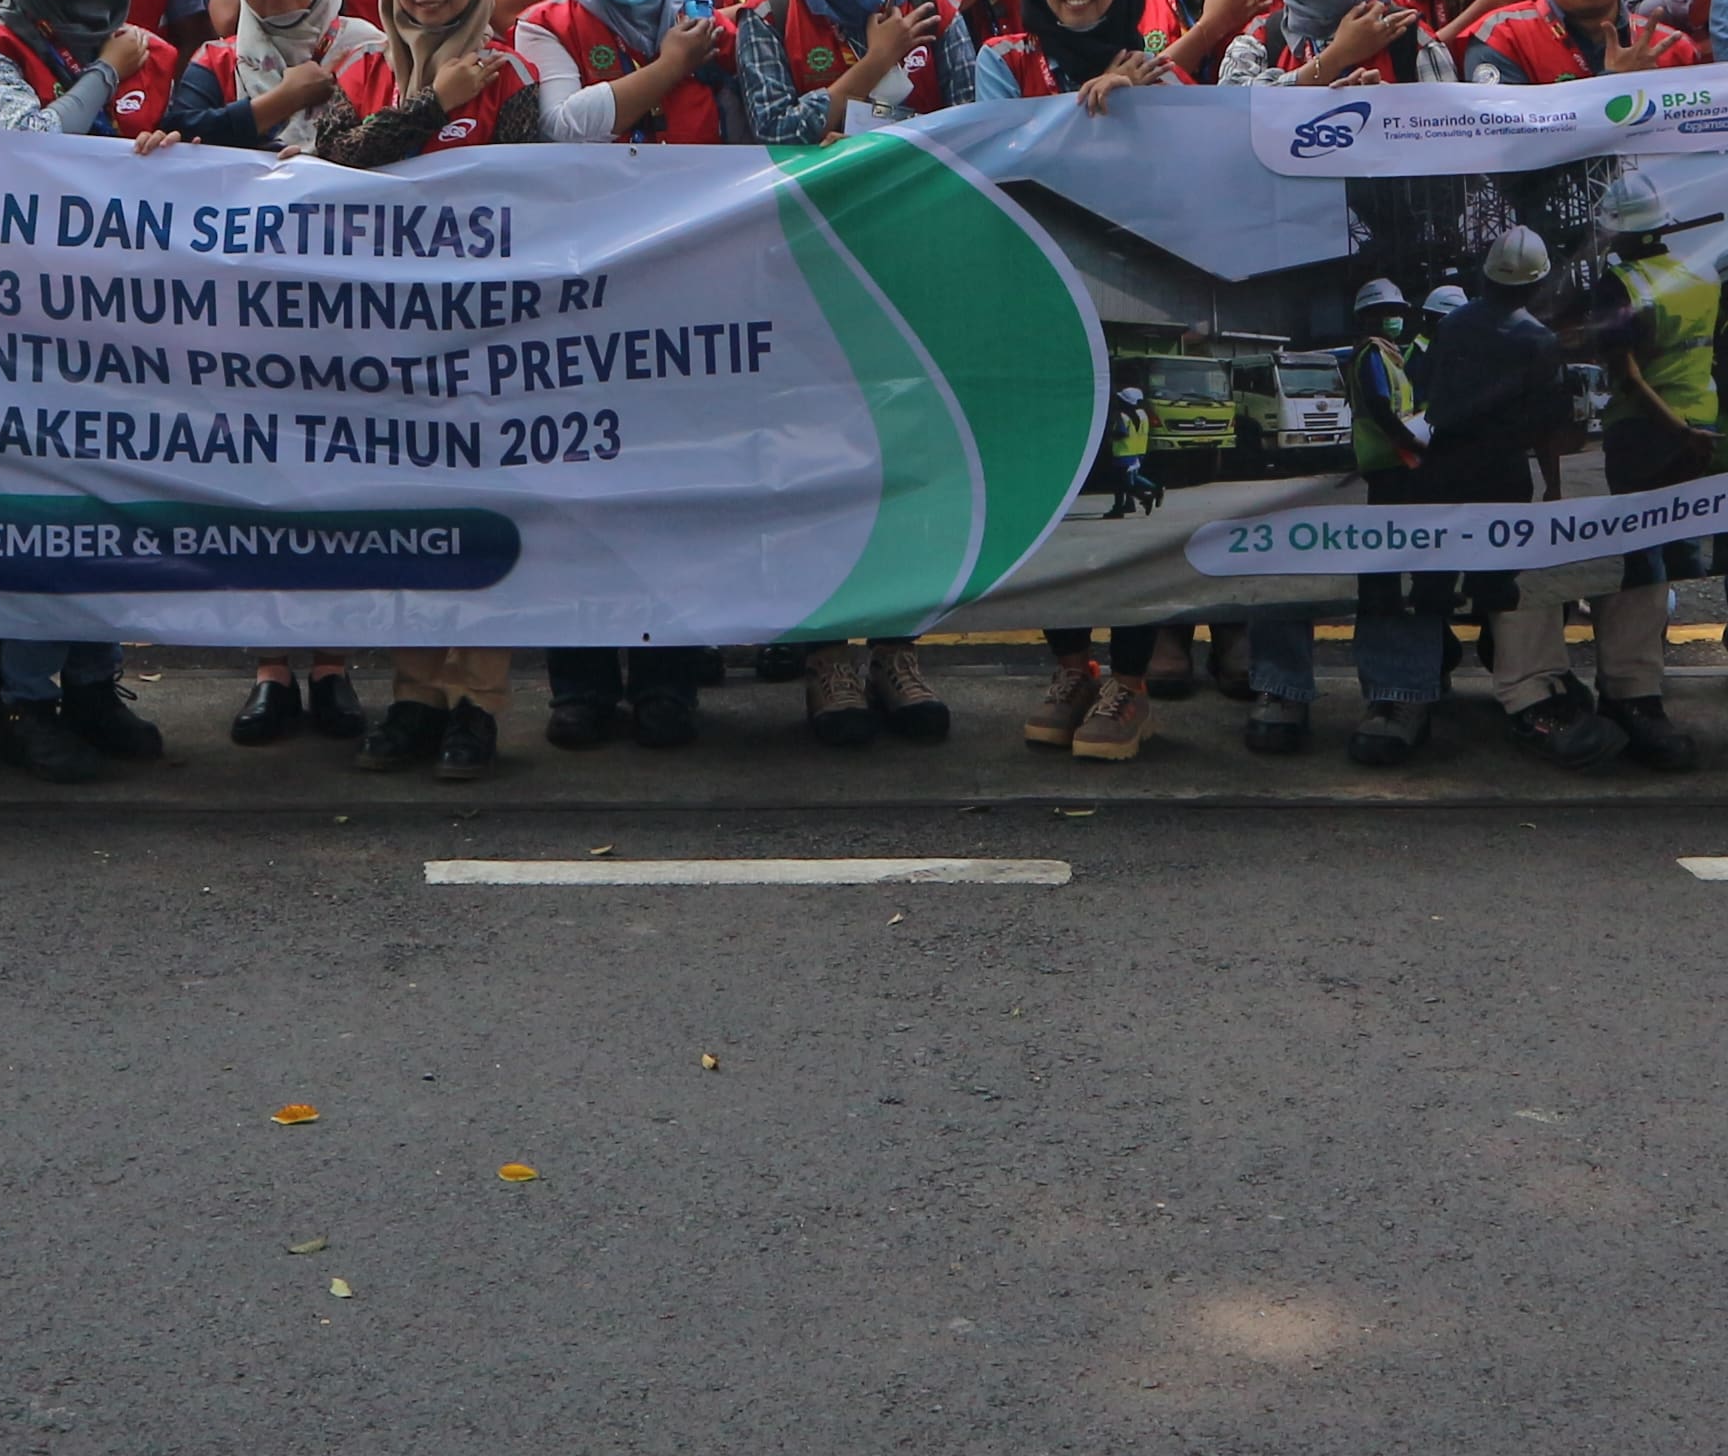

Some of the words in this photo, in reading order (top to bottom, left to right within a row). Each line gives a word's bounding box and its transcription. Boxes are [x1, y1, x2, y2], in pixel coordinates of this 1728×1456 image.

[1383, 117, 1405, 129] PT.
[1410, 114, 1475, 128] Sinarindo
[1479, 112, 1524, 125] Global
[1529, 111, 1577, 124] Sarana
[1662, 91, 1712, 108] BPJS
[1294, 123, 1354, 149] SGS
[1425, 129, 1473, 139] Consulting
[1484, 125, 1538, 135] Certification
[57, 194, 175, 252] DAN
[191, 204, 513, 259] SERTIFIKASI
[39, 273, 219, 328] UMUM
[237, 279, 542, 332] KEMNAKER
[558, 274, 608, 317] RI
[189, 348, 470, 399] PROMOTIF
[489, 320, 774, 396] PREVENTIF
[295, 412, 481, 469] TAHUN
[499, 408, 622, 467] 2023
[132, 529, 162, 556] &
[173, 525, 461, 558] BANYUWANGI
[1228, 526, 1272, 554] 23
[1289, 521, 1448, 552] Oktober
[1487, 519, 1535, 548] 09
[1550, 491, 1726, 545] November
